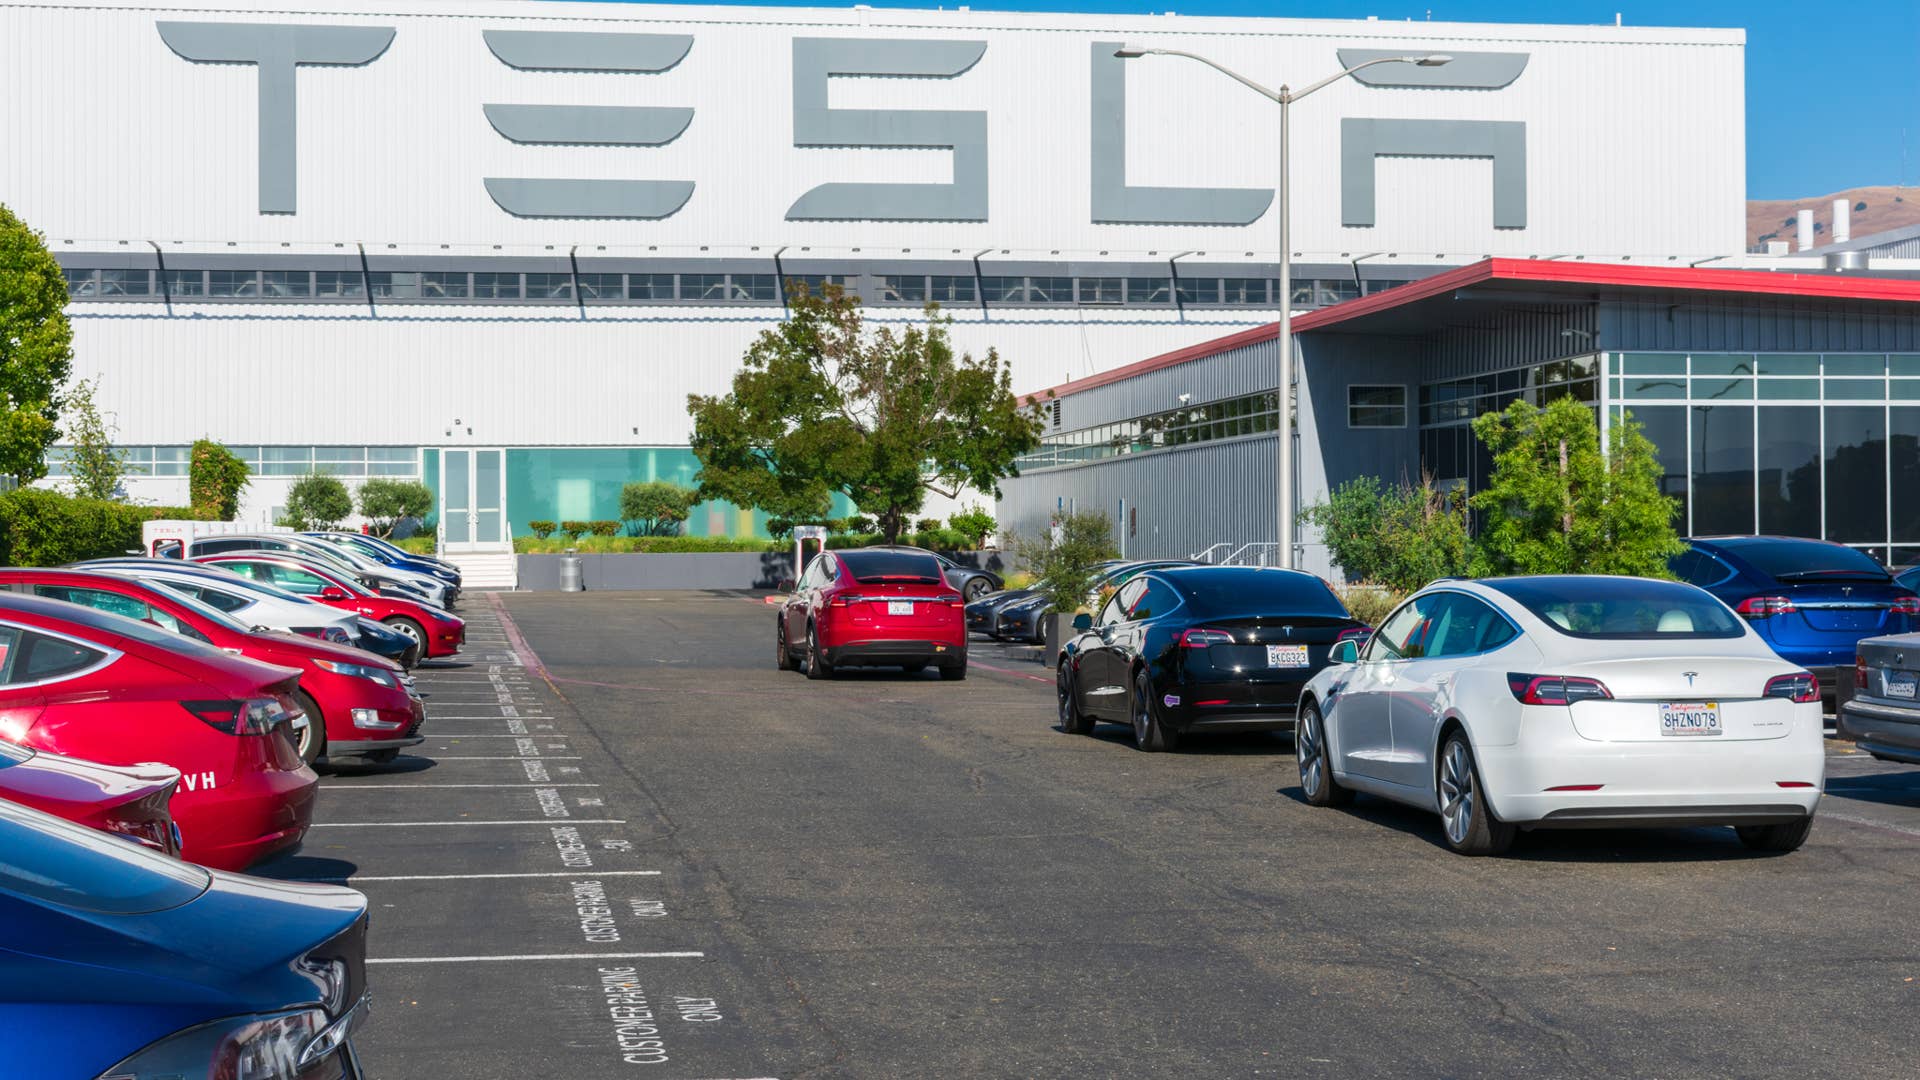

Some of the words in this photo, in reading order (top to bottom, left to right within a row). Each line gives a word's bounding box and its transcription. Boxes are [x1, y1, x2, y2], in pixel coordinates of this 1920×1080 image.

[157, 21, 1530, 230] TESLA
[1664, 712, 1716, 727] 8HZN078
[674, 996, 723, 1021] ONLY
[610, 1006, 668, 1063] CUSTOMER
